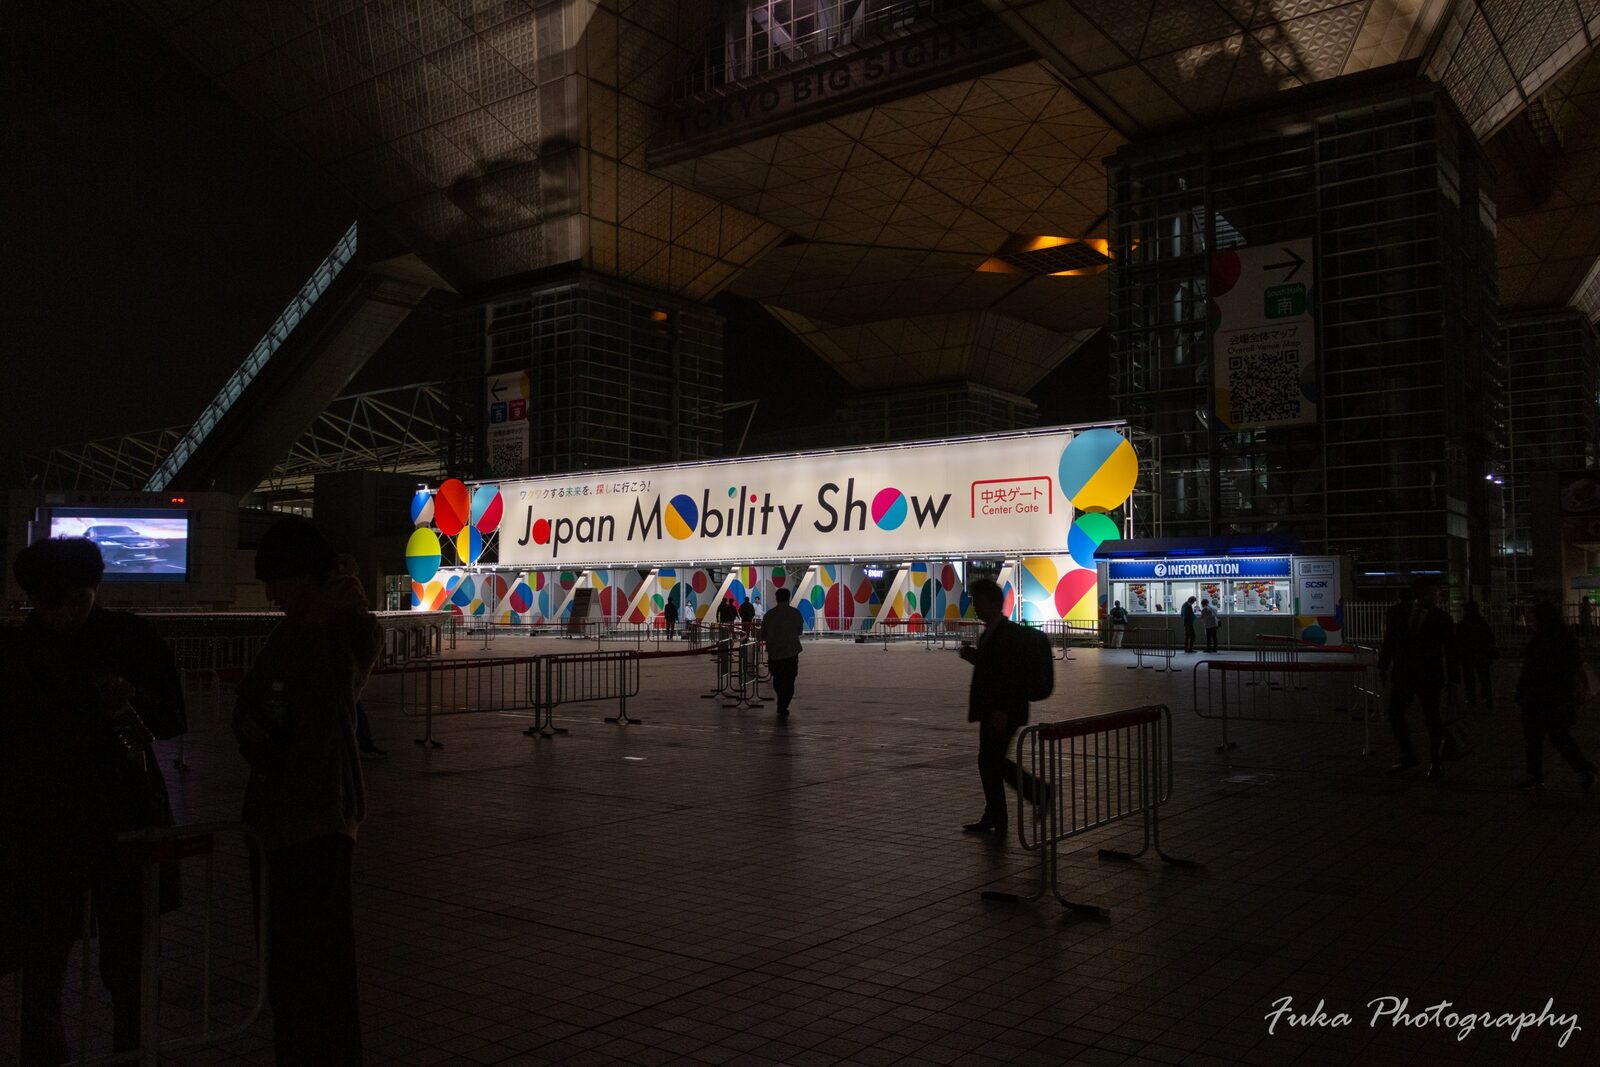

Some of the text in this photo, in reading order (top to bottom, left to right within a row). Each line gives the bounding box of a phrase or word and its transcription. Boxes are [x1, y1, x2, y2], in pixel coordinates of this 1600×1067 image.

[674, 25, 982, 139] TOKYO BIG SIGHT
[1276, 297, 1293, 316] 南
[981, 486, 1043, 504] 中央ゲート
[518, 477, 952, 558] Japan Mobility Show
[982, 502, 1039, 515] Center Gate
[1167, 563, 1239, 576] INFORMATION
[1305, 581, 1328, 589] SCSK
